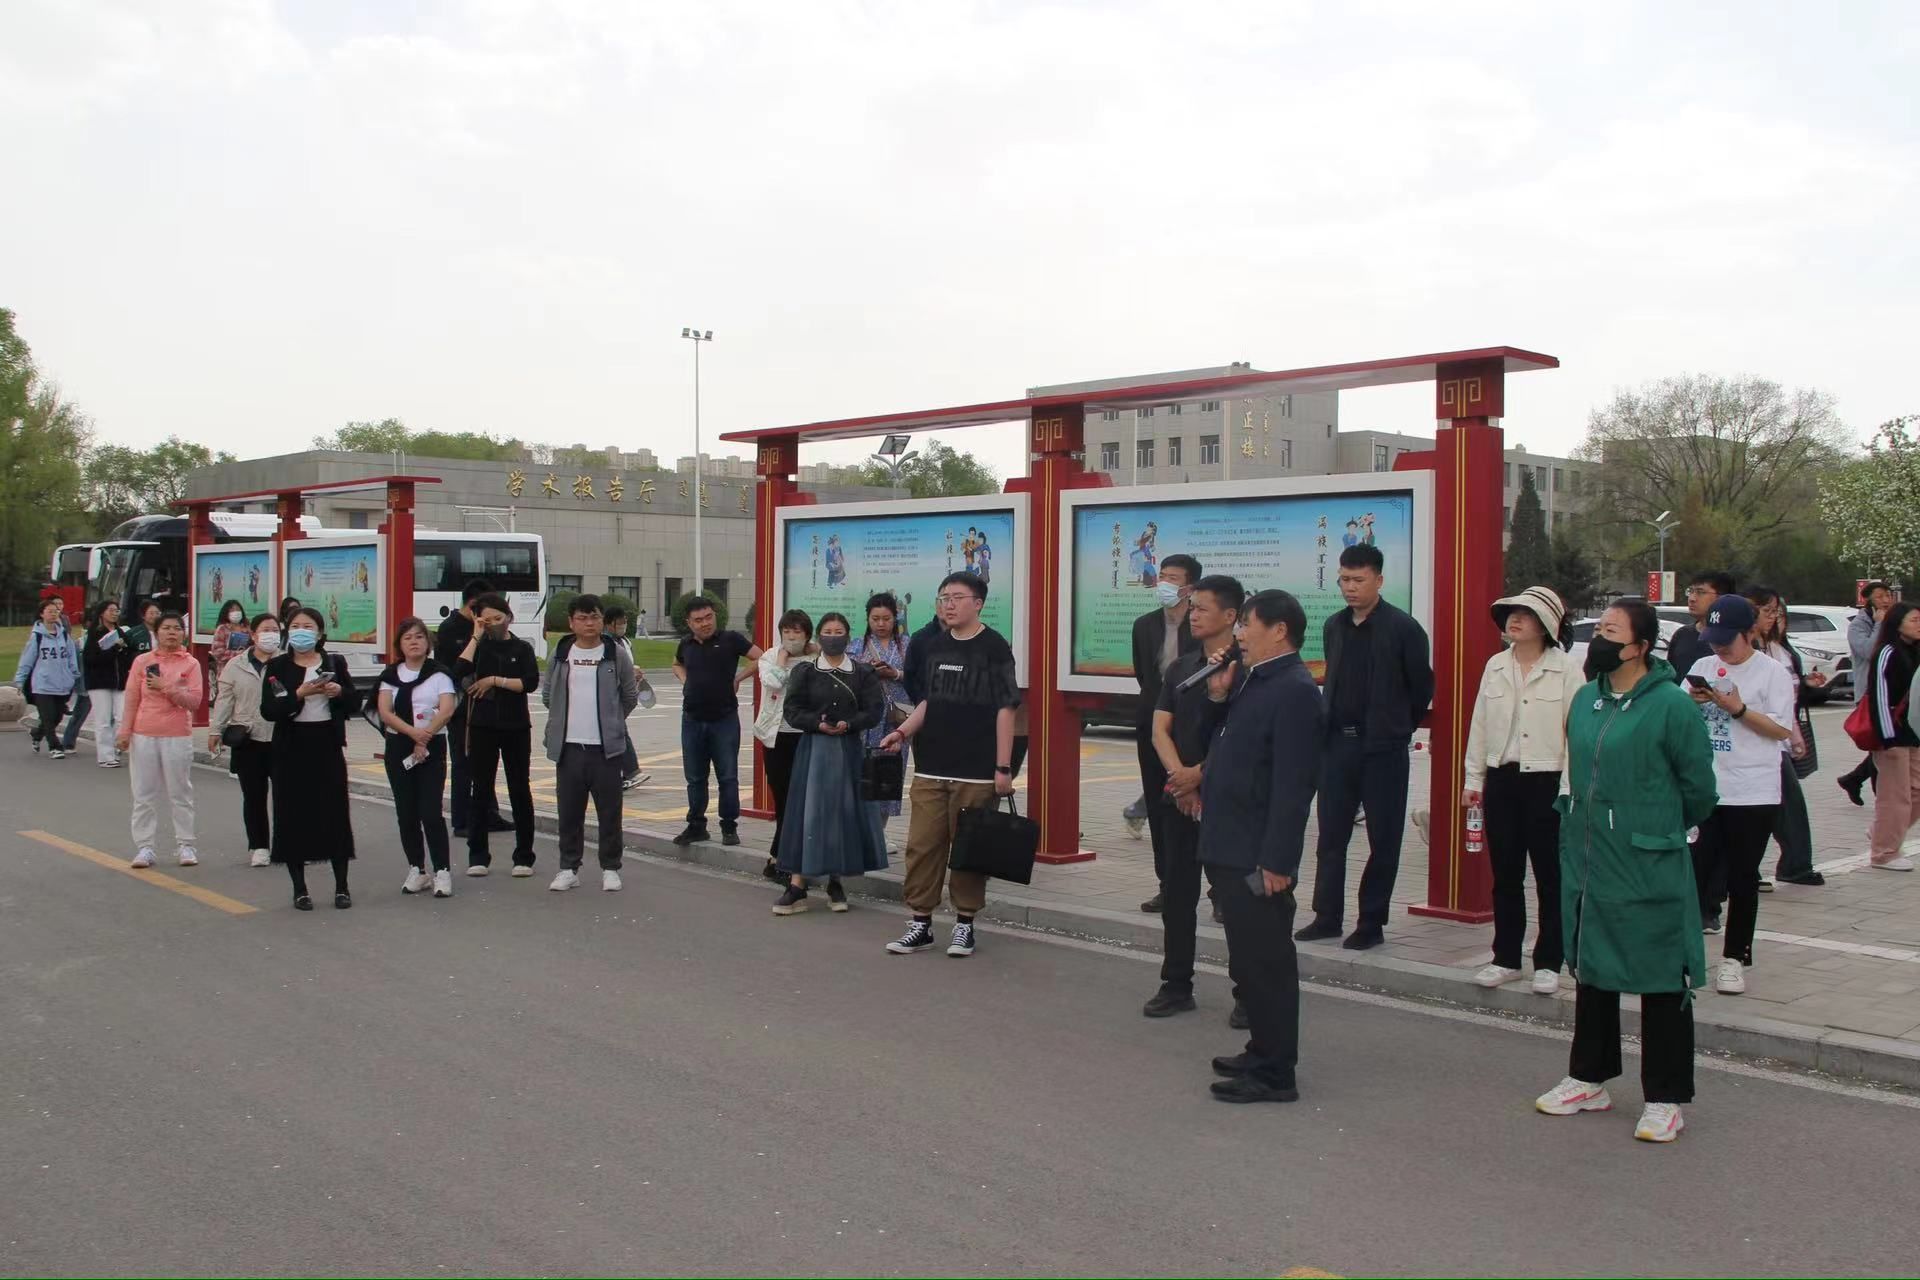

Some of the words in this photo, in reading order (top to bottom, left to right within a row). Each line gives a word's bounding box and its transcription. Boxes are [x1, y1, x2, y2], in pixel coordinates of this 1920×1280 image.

[505, 469, 656, 504] 学术报告厅
